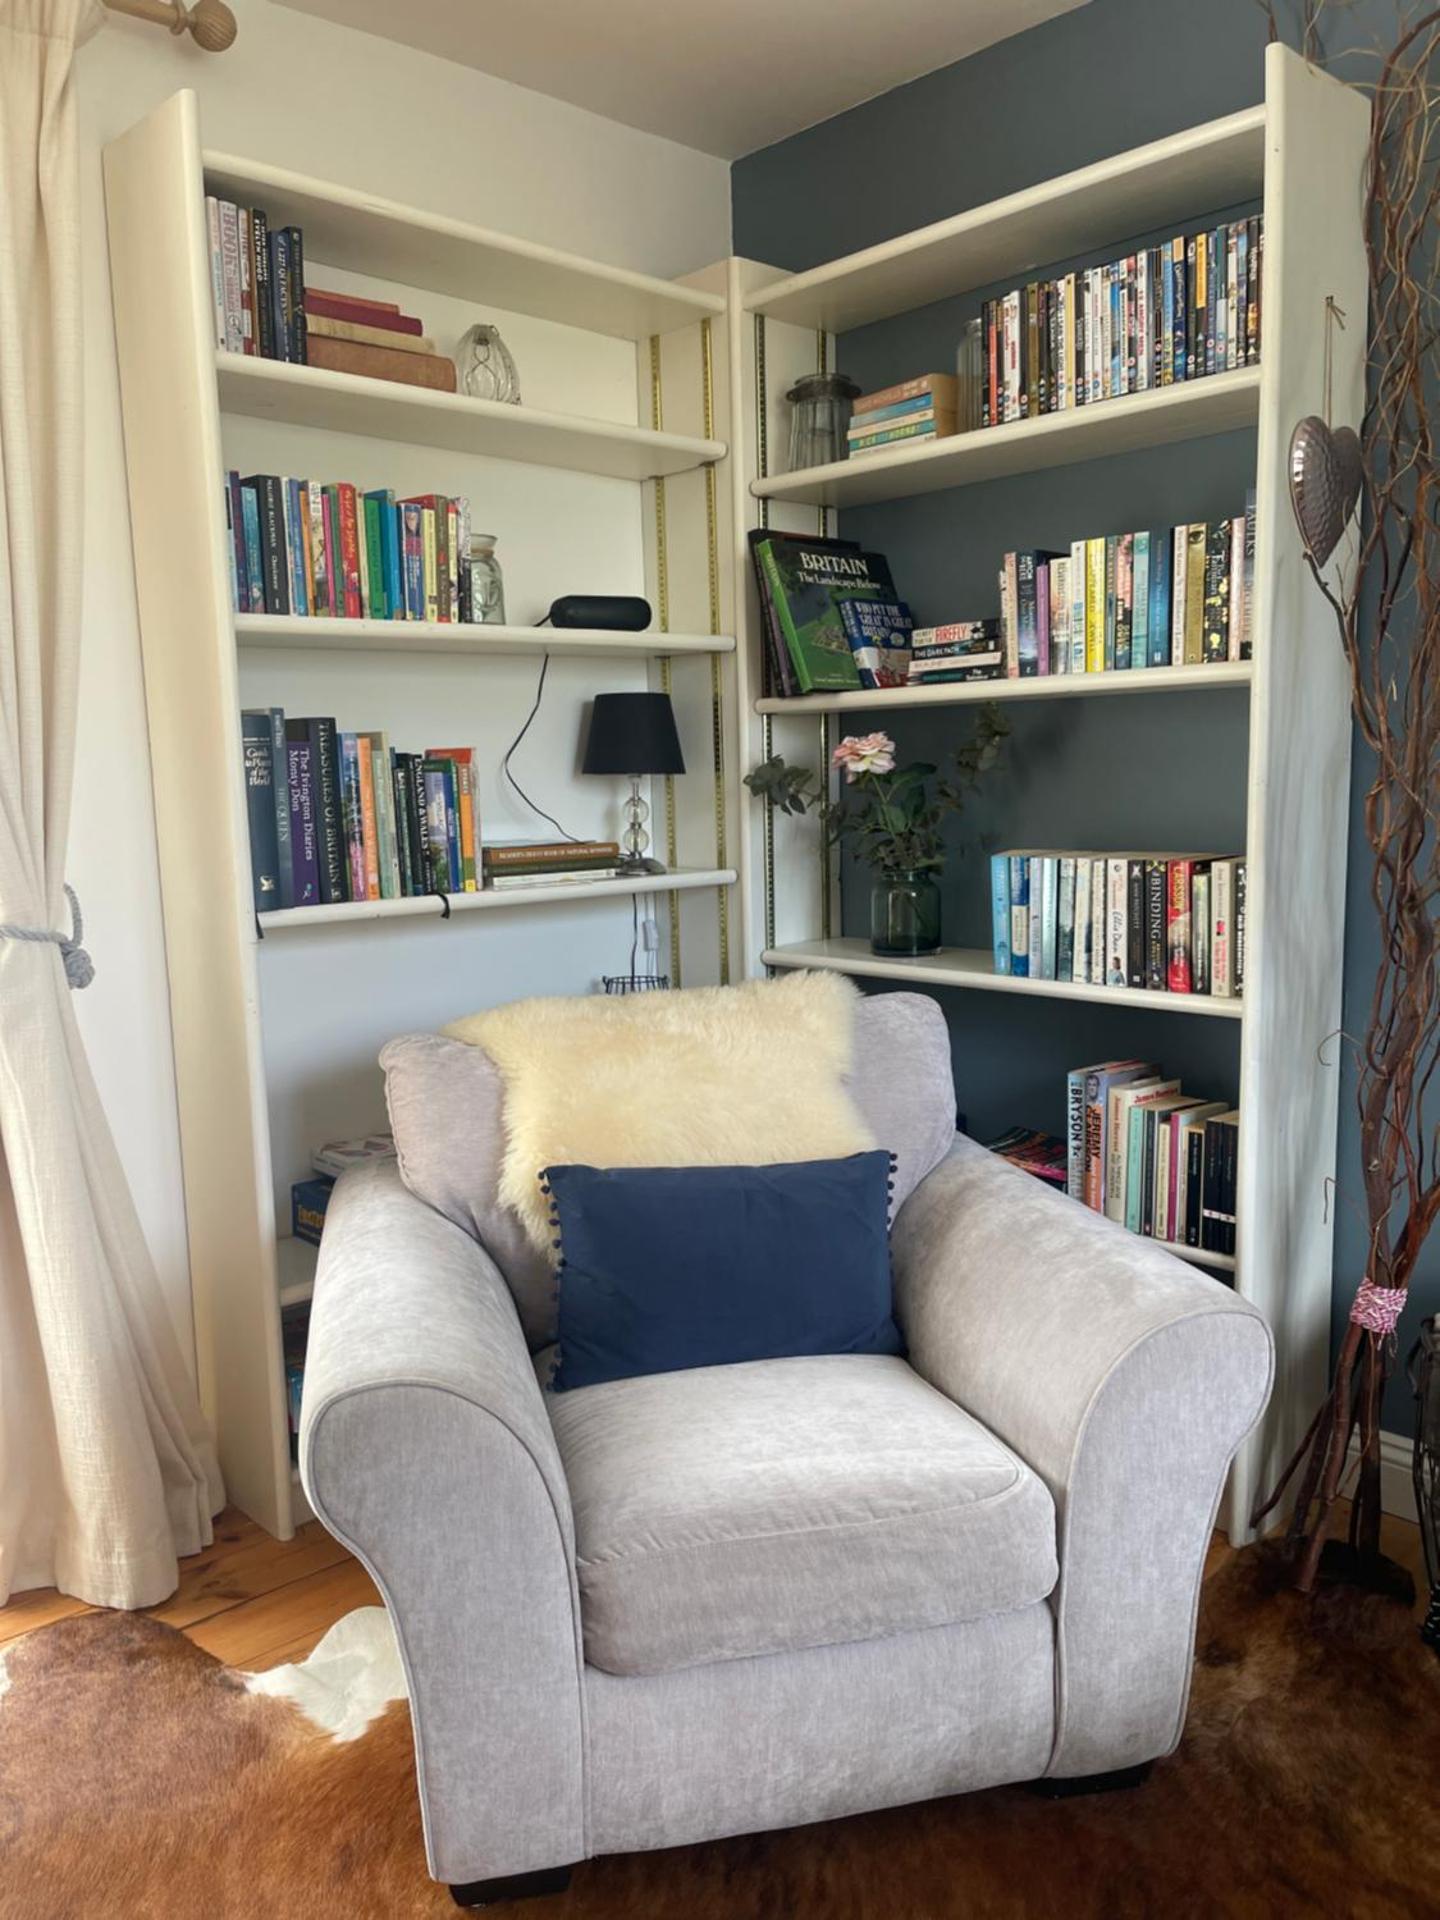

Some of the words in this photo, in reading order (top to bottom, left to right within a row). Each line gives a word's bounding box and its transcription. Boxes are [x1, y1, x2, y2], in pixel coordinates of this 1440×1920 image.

[254, 218, 263, 253] EVELYN
[256, 255, 265, 282] HUGO
[797, 571, 815, 584] The
[815, 573, 857, 589] Landscape
[800, 552, 869, 575] BRITAIN
[935, 625, 969, 643] FIREFLY
[288, 749, 299, 786] Monty
[300, 748, 311, 769] The
[319, 722, 334, 804] TREASURES
[290, 789, 301, 812] Don
[300, 773, 312, 820] Ivington
[414, 758, 427, 806] ENGLAND
[277, 806, 289, 843] QUEEN
[325, 807, 336, 824] OF
[419, 816, 431, 850] WALES
[304, 823, 314, 860] Diaries
[326, 829, 340, 883] BRITAIN
[1151, 877, 1162, 939] BINDING
[1071, 1088, 1083, 1141] BRYSON
[1091, 1109, 1102, 1159] JEREMY
